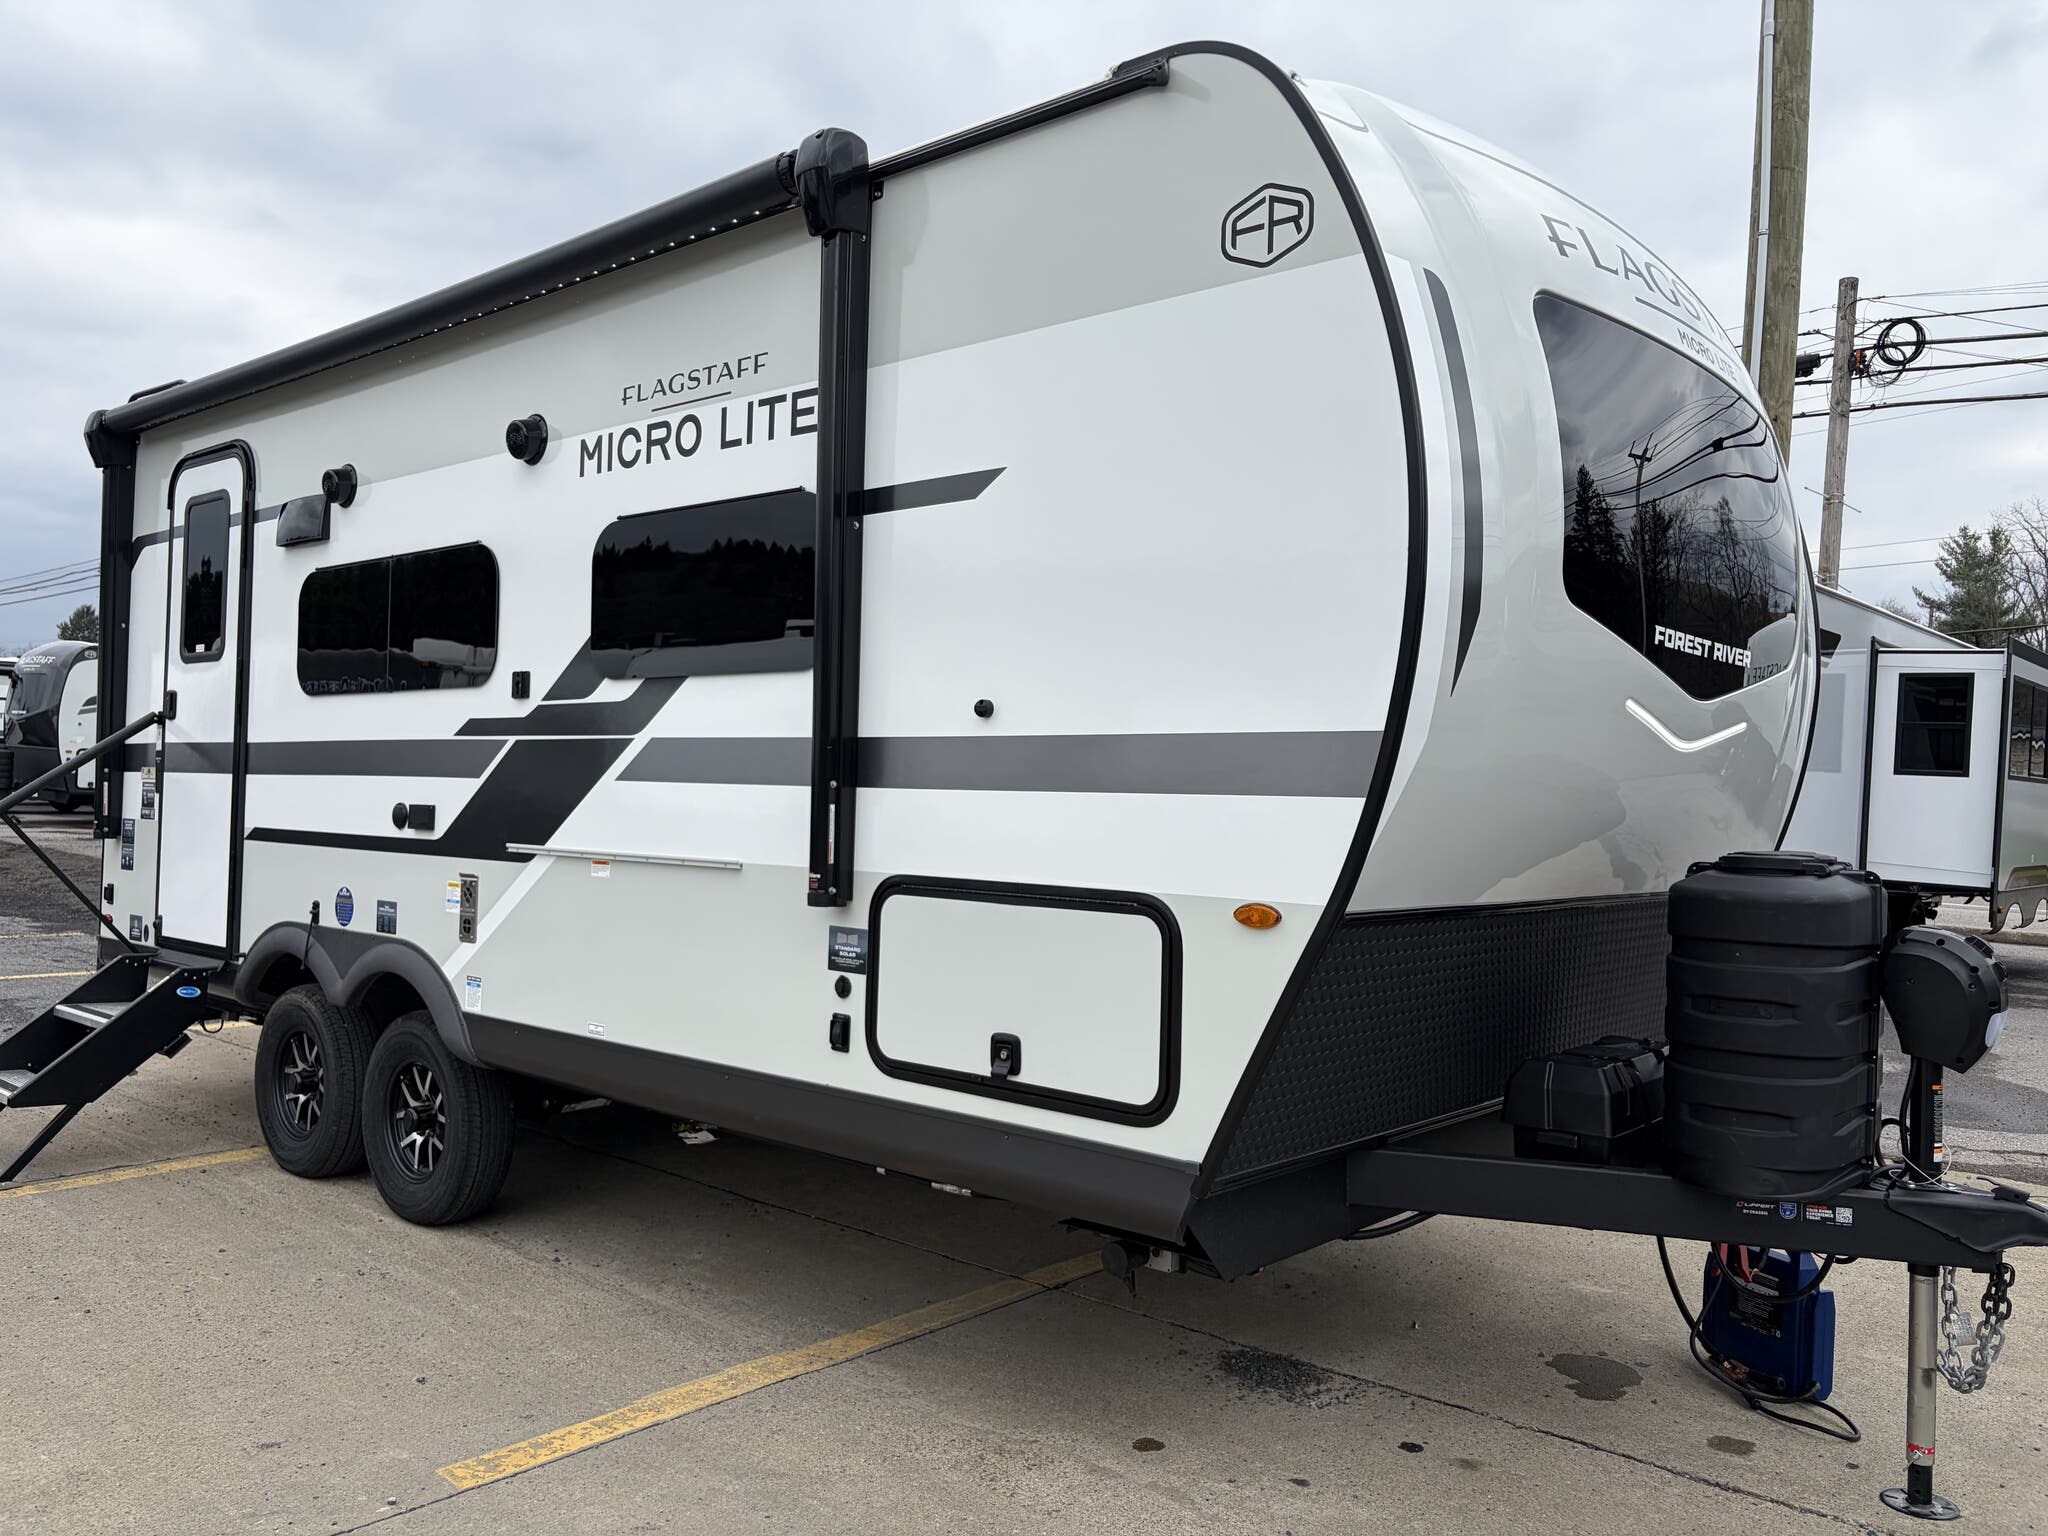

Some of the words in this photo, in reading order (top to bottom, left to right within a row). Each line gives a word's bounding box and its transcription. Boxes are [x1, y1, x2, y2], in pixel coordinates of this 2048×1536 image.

[1677, 328, 1715, 365] MICRO
[621, 352, 768, 405] FLAGSTAFF
[720, 387, 819, 450] LITE
[579, 413, 702, 477] MICRO
[1655, 625, 1712, 657] FOREST
[1713, 642, 1751, 668] RIVER
[835, 944, 861, 953] STANDARD
[839, 950, 857, 958] SOLAR
